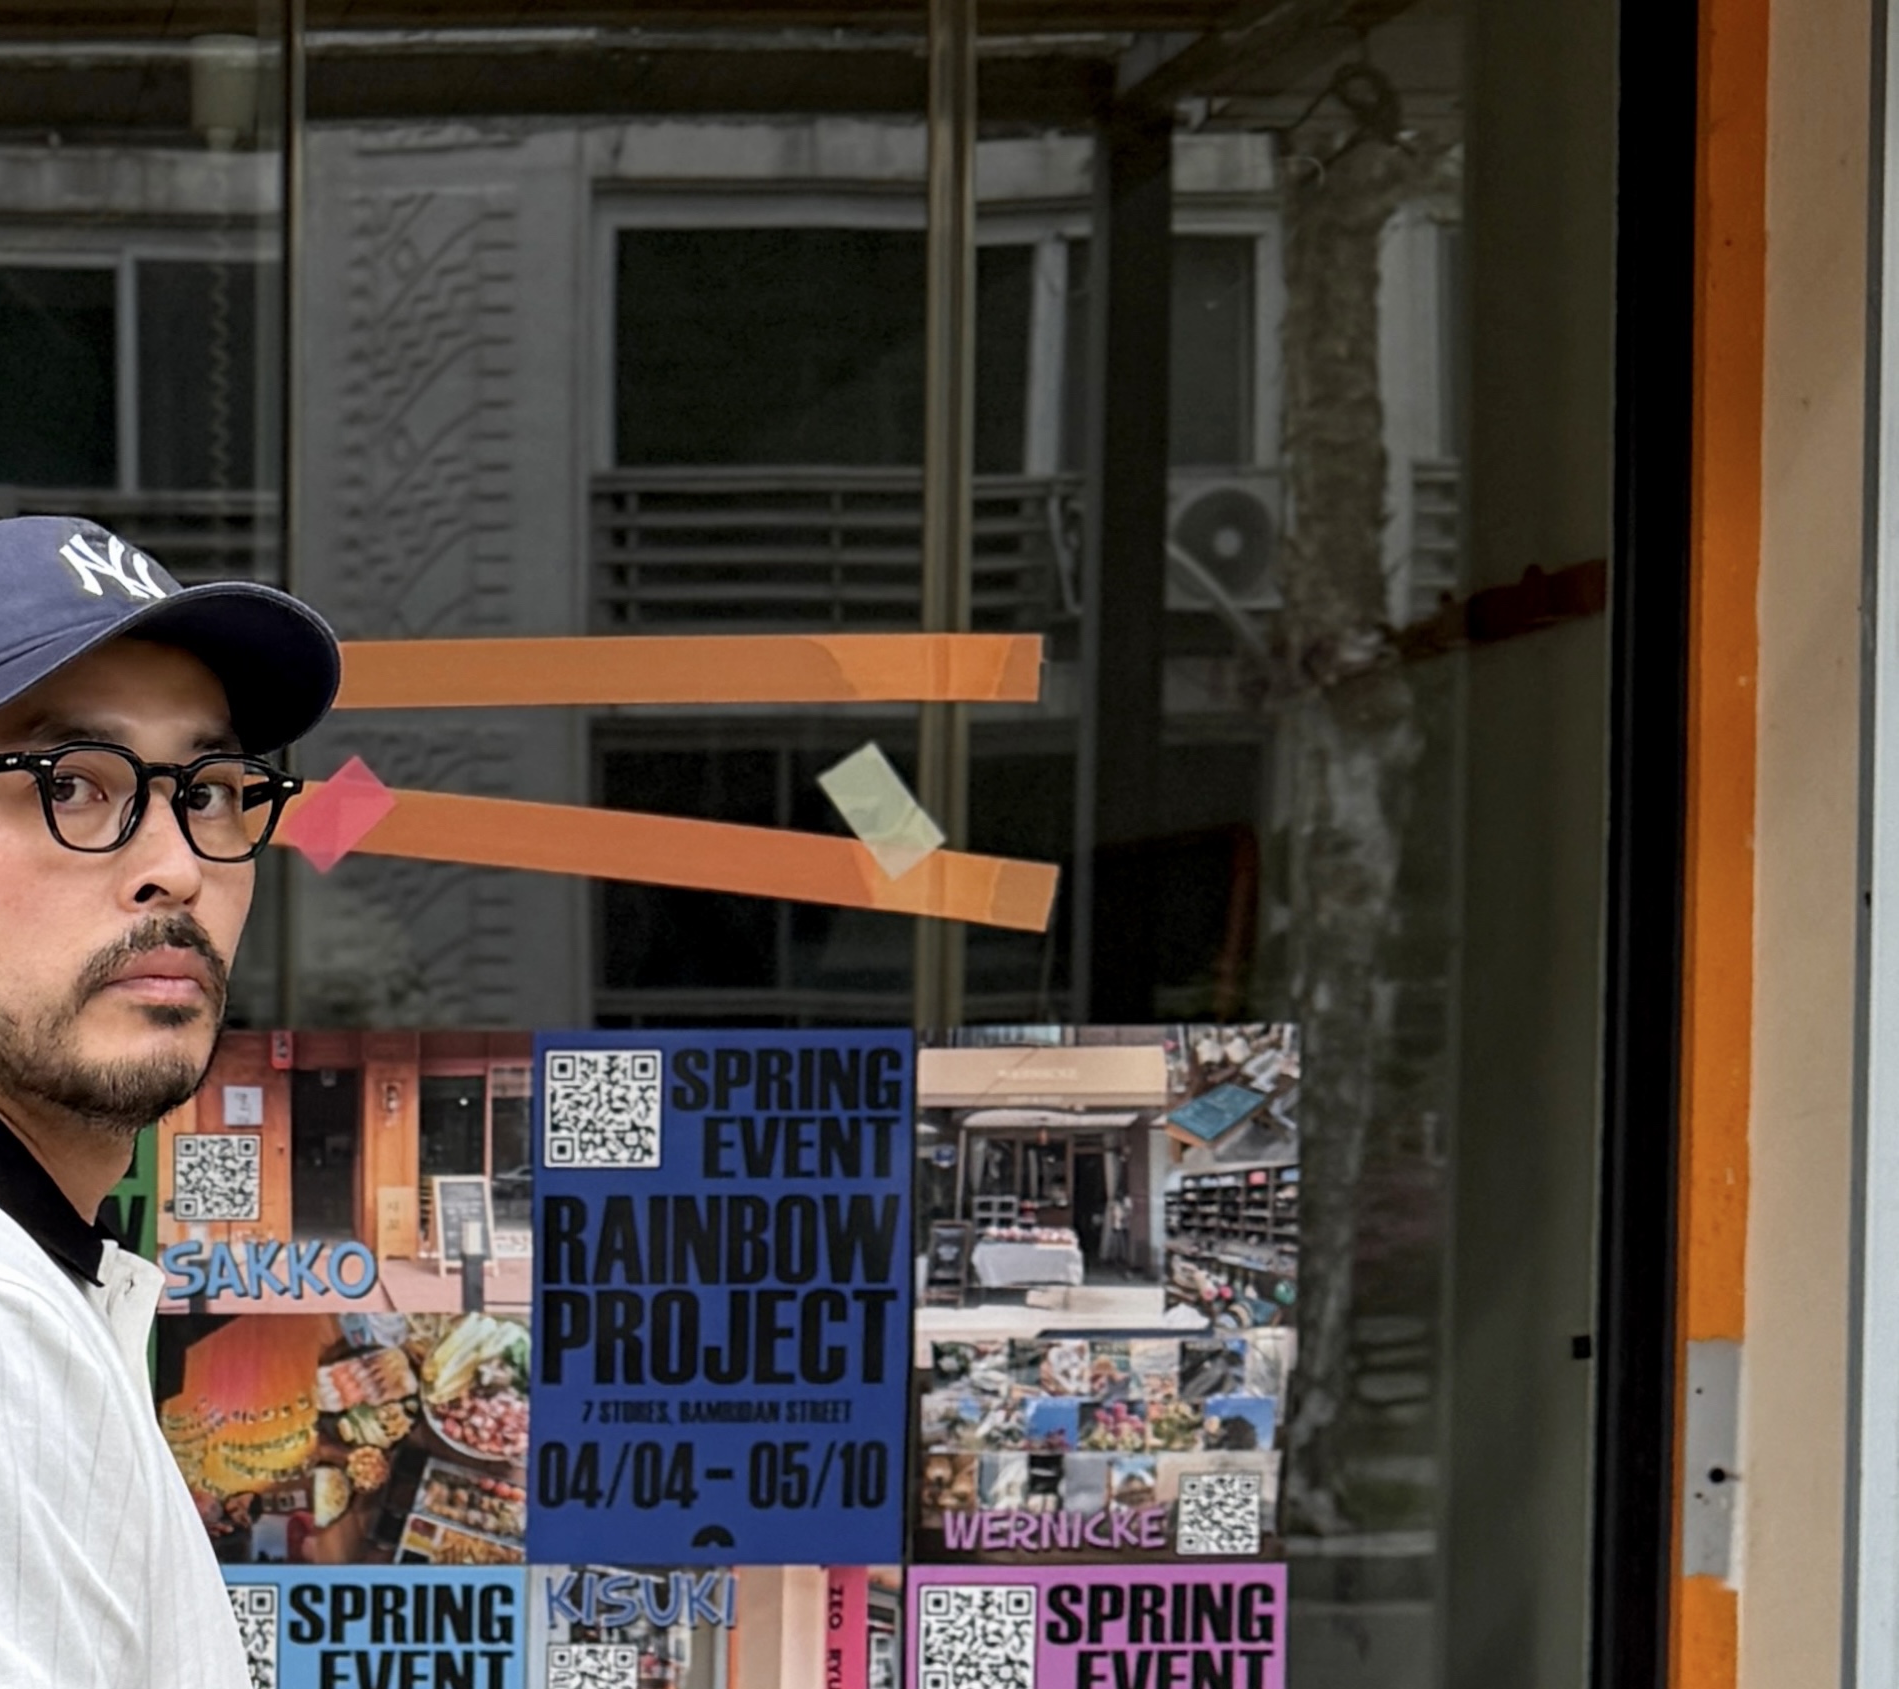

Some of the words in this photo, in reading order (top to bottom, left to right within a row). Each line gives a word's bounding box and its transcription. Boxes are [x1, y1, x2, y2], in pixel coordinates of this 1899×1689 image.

[671, 1047, 902, 1112] SPRING
[702, 1115, 901, 1179] EVENT
[162, 1240, 379, 1300] SAKKO
[541, 1194, 899, 1286] RAINBOW
[540, 1287, 898, 1386] PROJECT
[943, 1506, 1168, 1552] WERNICKE
[288, 1583, 514, 1645] SPRING
[545, 1571, 739, 1629] KISUKI
[1045, 1582, 1275, 1646] SPRING
